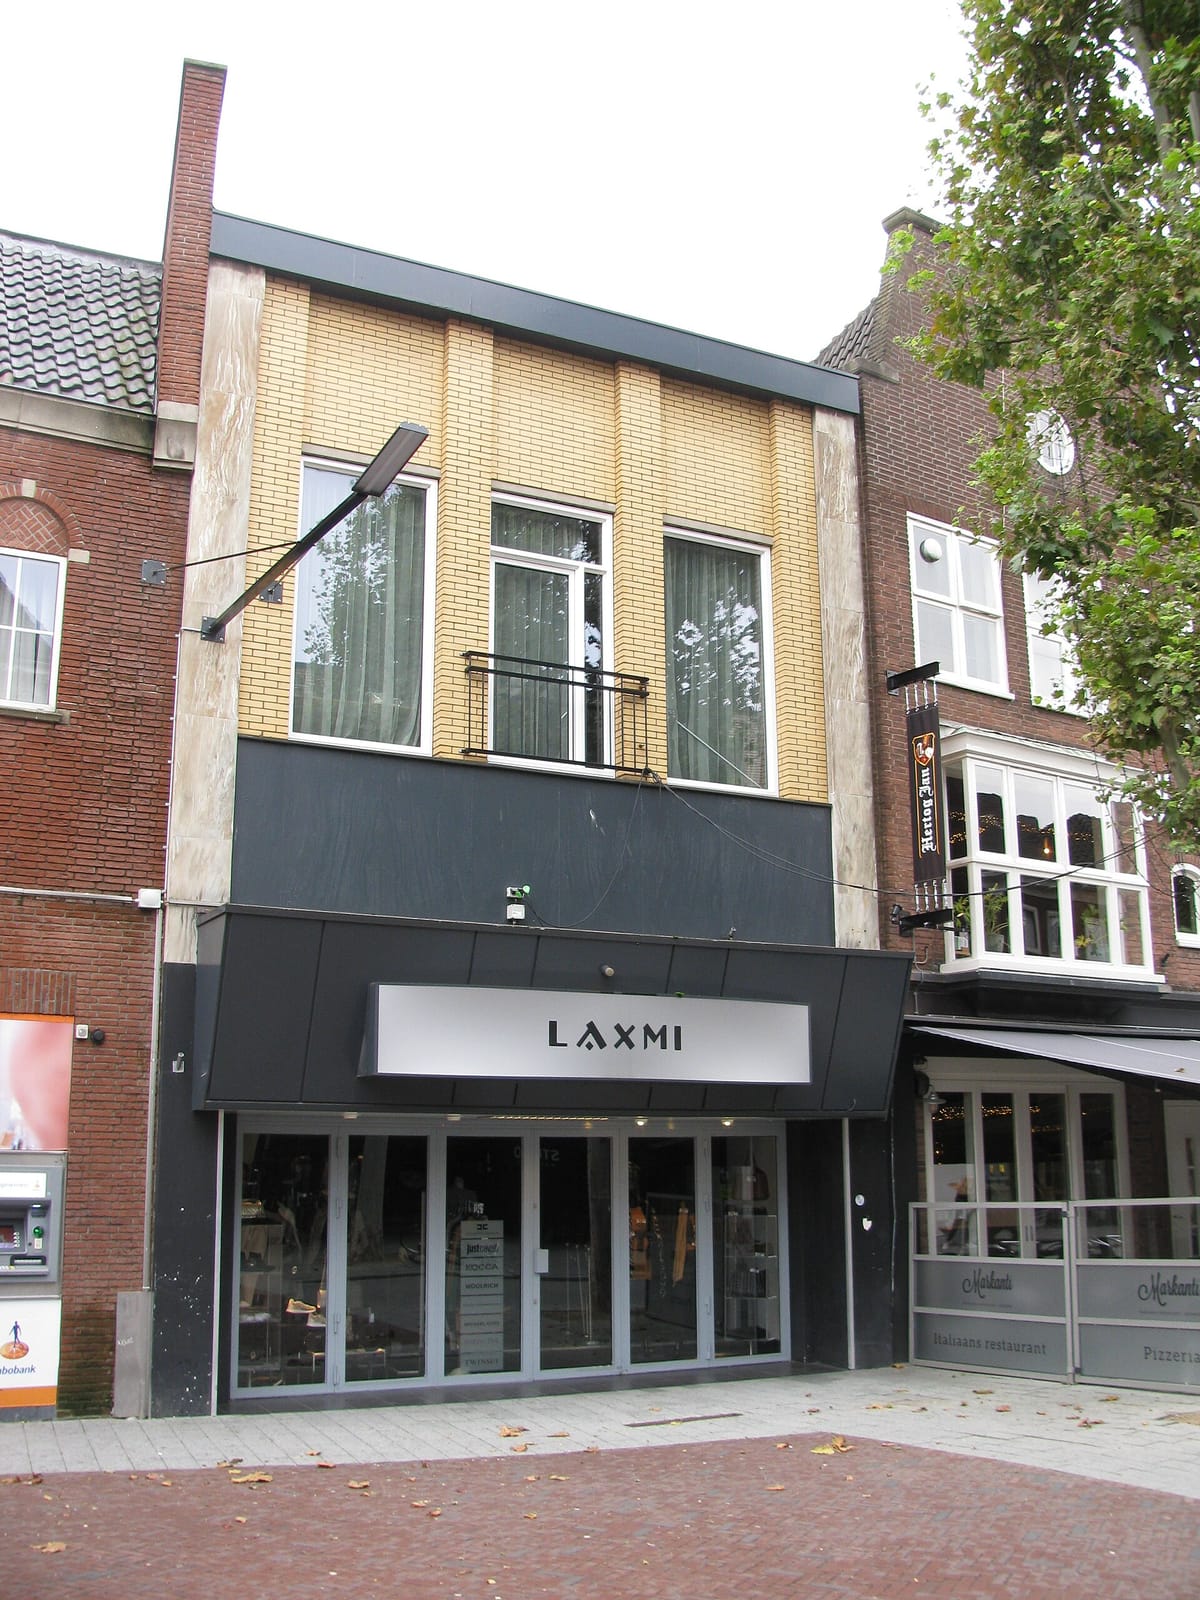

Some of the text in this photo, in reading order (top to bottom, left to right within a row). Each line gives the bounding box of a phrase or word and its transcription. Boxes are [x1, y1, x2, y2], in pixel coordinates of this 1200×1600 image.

[919, 767, 936, 853] Hertog Jan
[548, 1020, 682, 1051] LAXMI
[933, 1332, 1047, 1356] Italiaans restaurant
